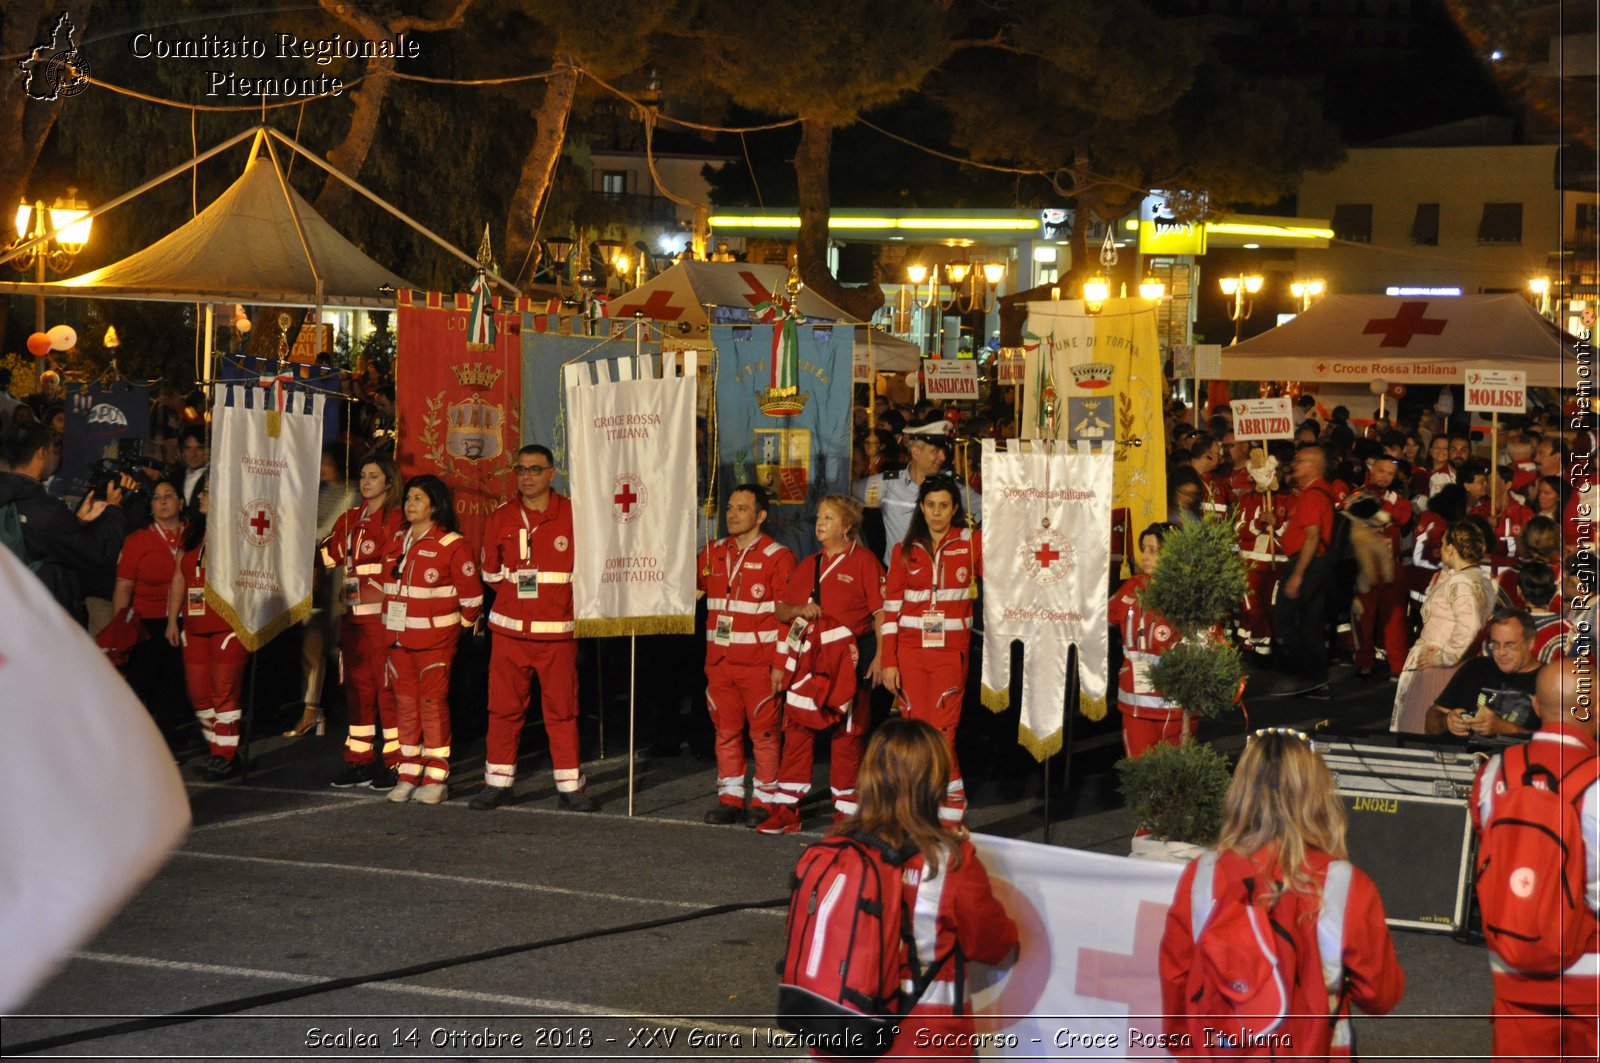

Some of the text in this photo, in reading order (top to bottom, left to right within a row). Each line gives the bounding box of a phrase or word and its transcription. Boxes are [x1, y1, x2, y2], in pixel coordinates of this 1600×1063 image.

[1086, 337, 1097, 347] DI
[1333, 363, 1457, 375] Croce Rossa Italiana
[928, 378, 976, 394] BASILICATA
[1468, 389, 1523, 407] MOLISE
[594, 413, 661, 428] CROCE ROSSA
[1238, 417, 1291, 435] ABRUZZO
[605, 556, 657, 569] COMITATO
[623, 570, 665, 582] TAURO
[1352, 796, 1398, 813] FRONT
